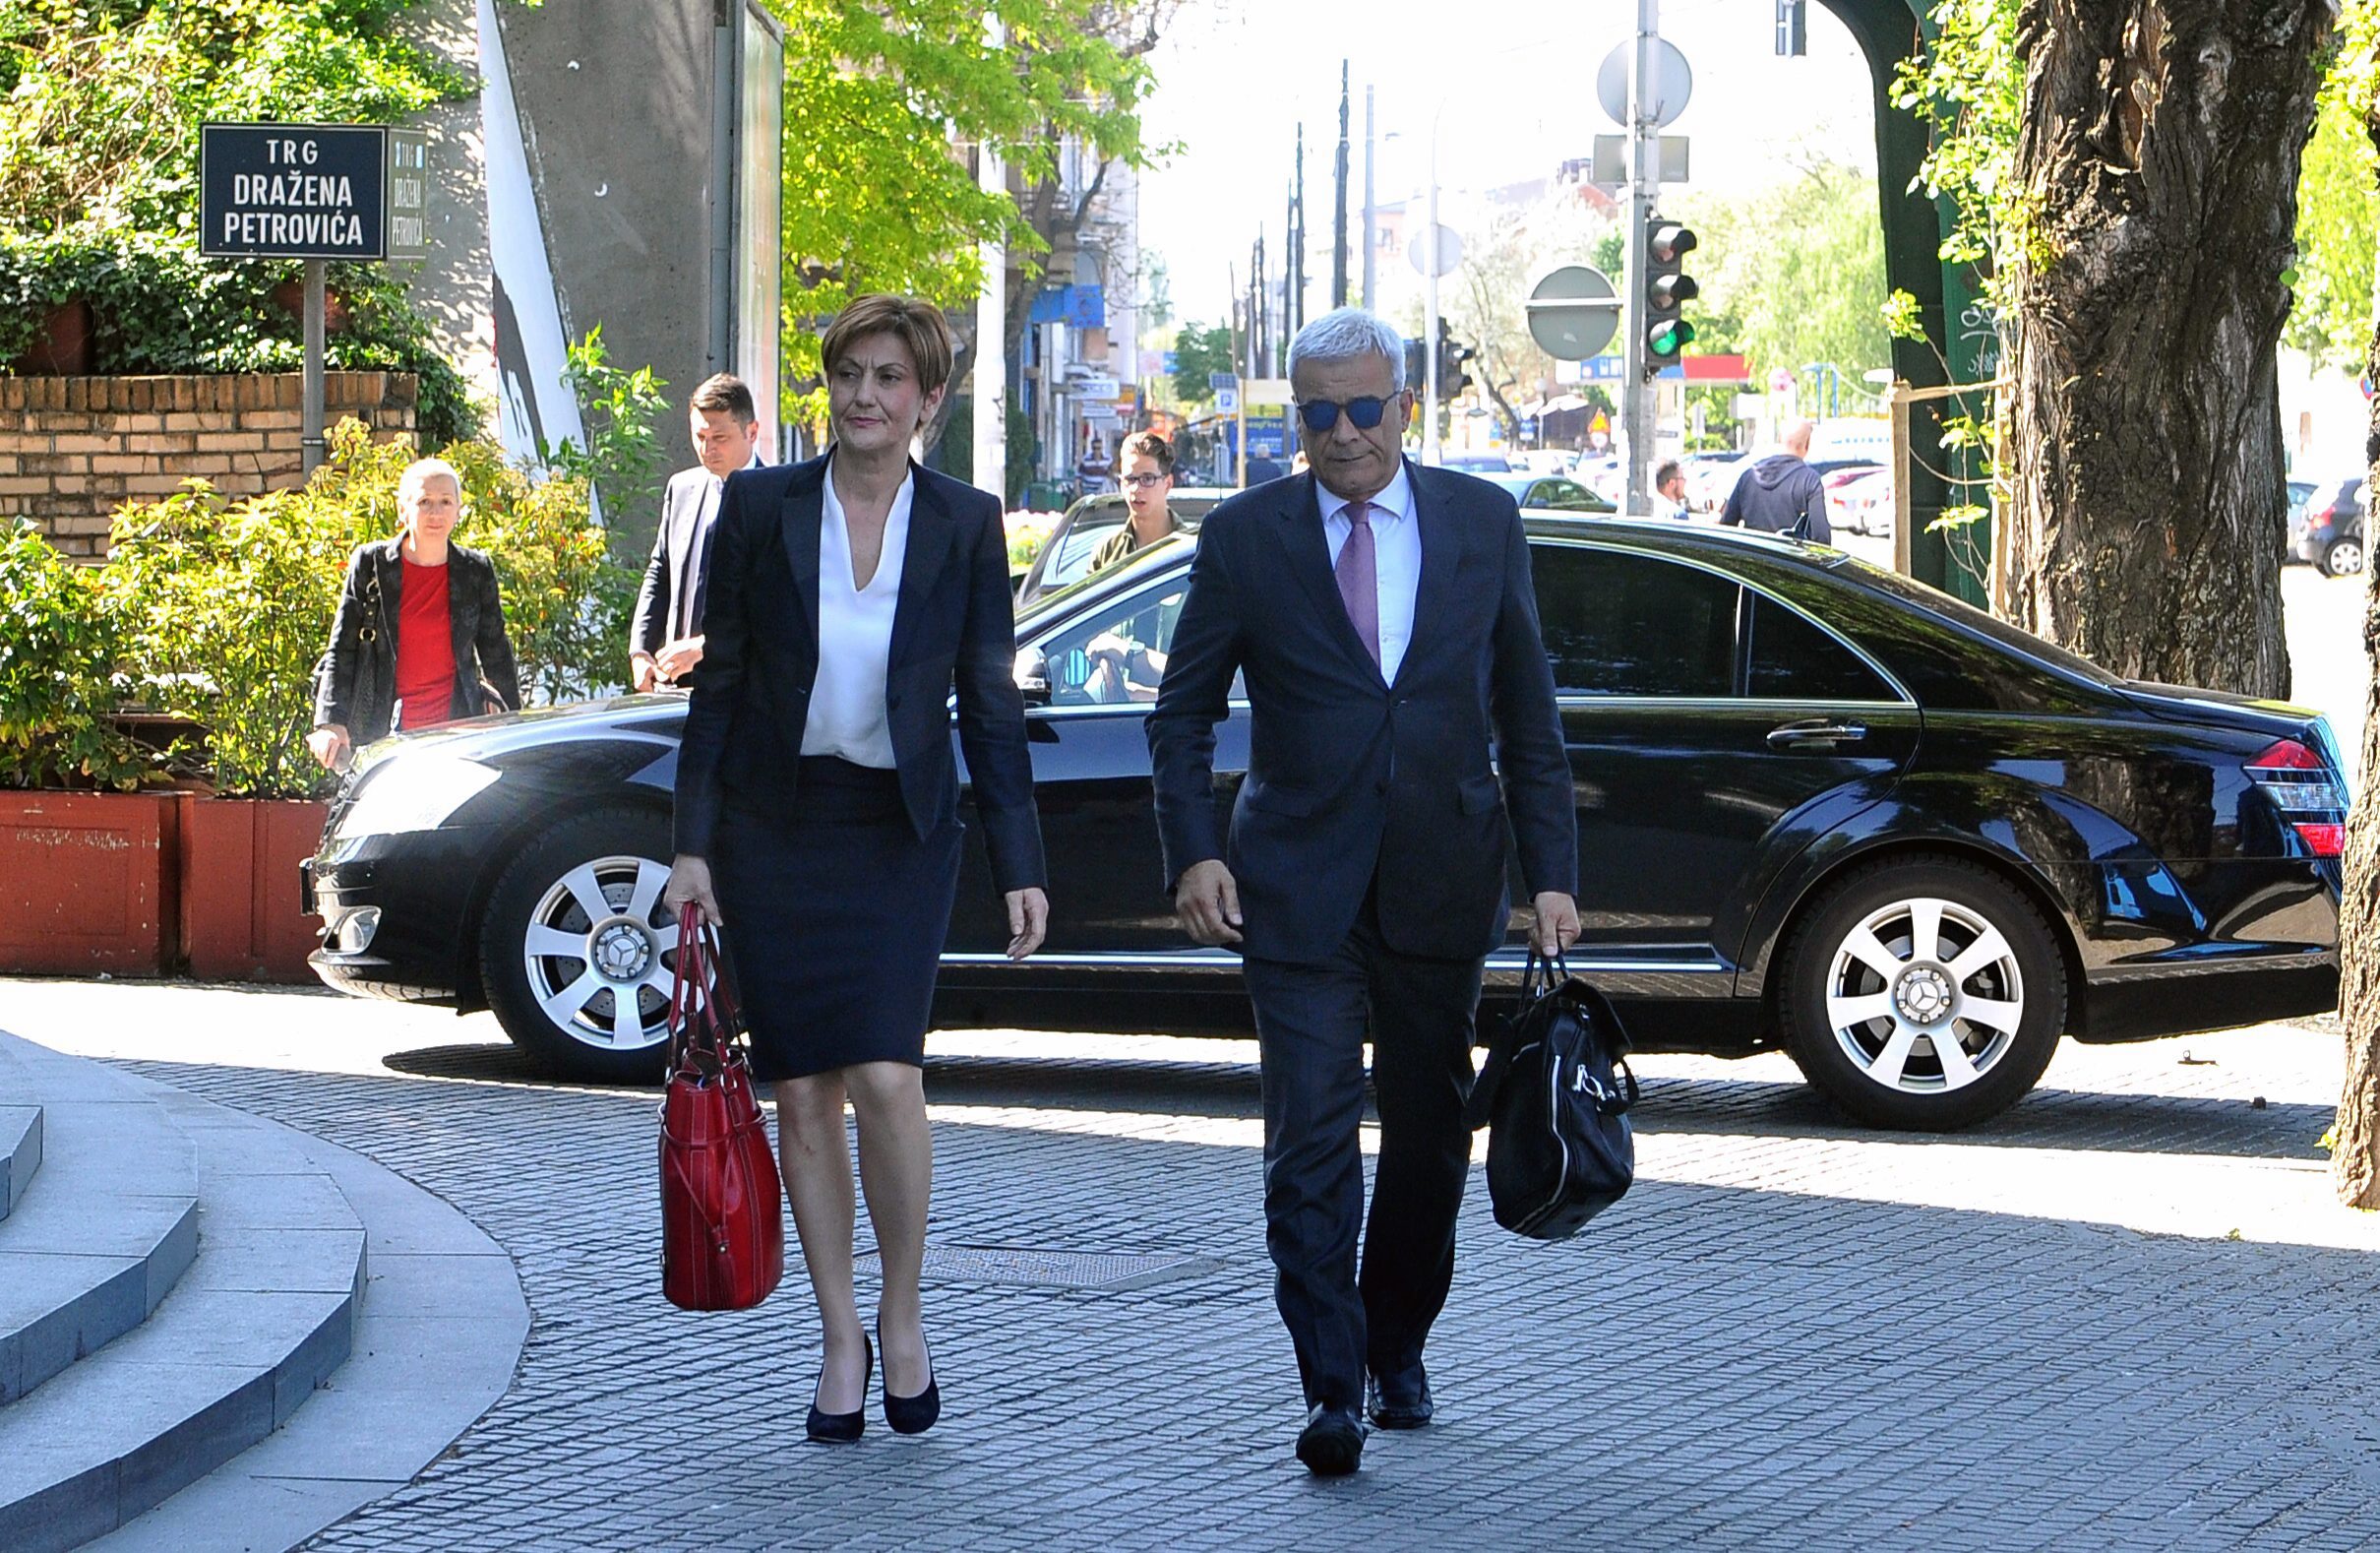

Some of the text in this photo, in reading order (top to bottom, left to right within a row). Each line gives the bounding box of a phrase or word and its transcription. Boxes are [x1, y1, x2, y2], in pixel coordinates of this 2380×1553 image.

[266, 139, 319, 165] TRG
[233, 169, 353, 208] DRAŽENA
[223, 210, 364, 246] PETROVIĆA
